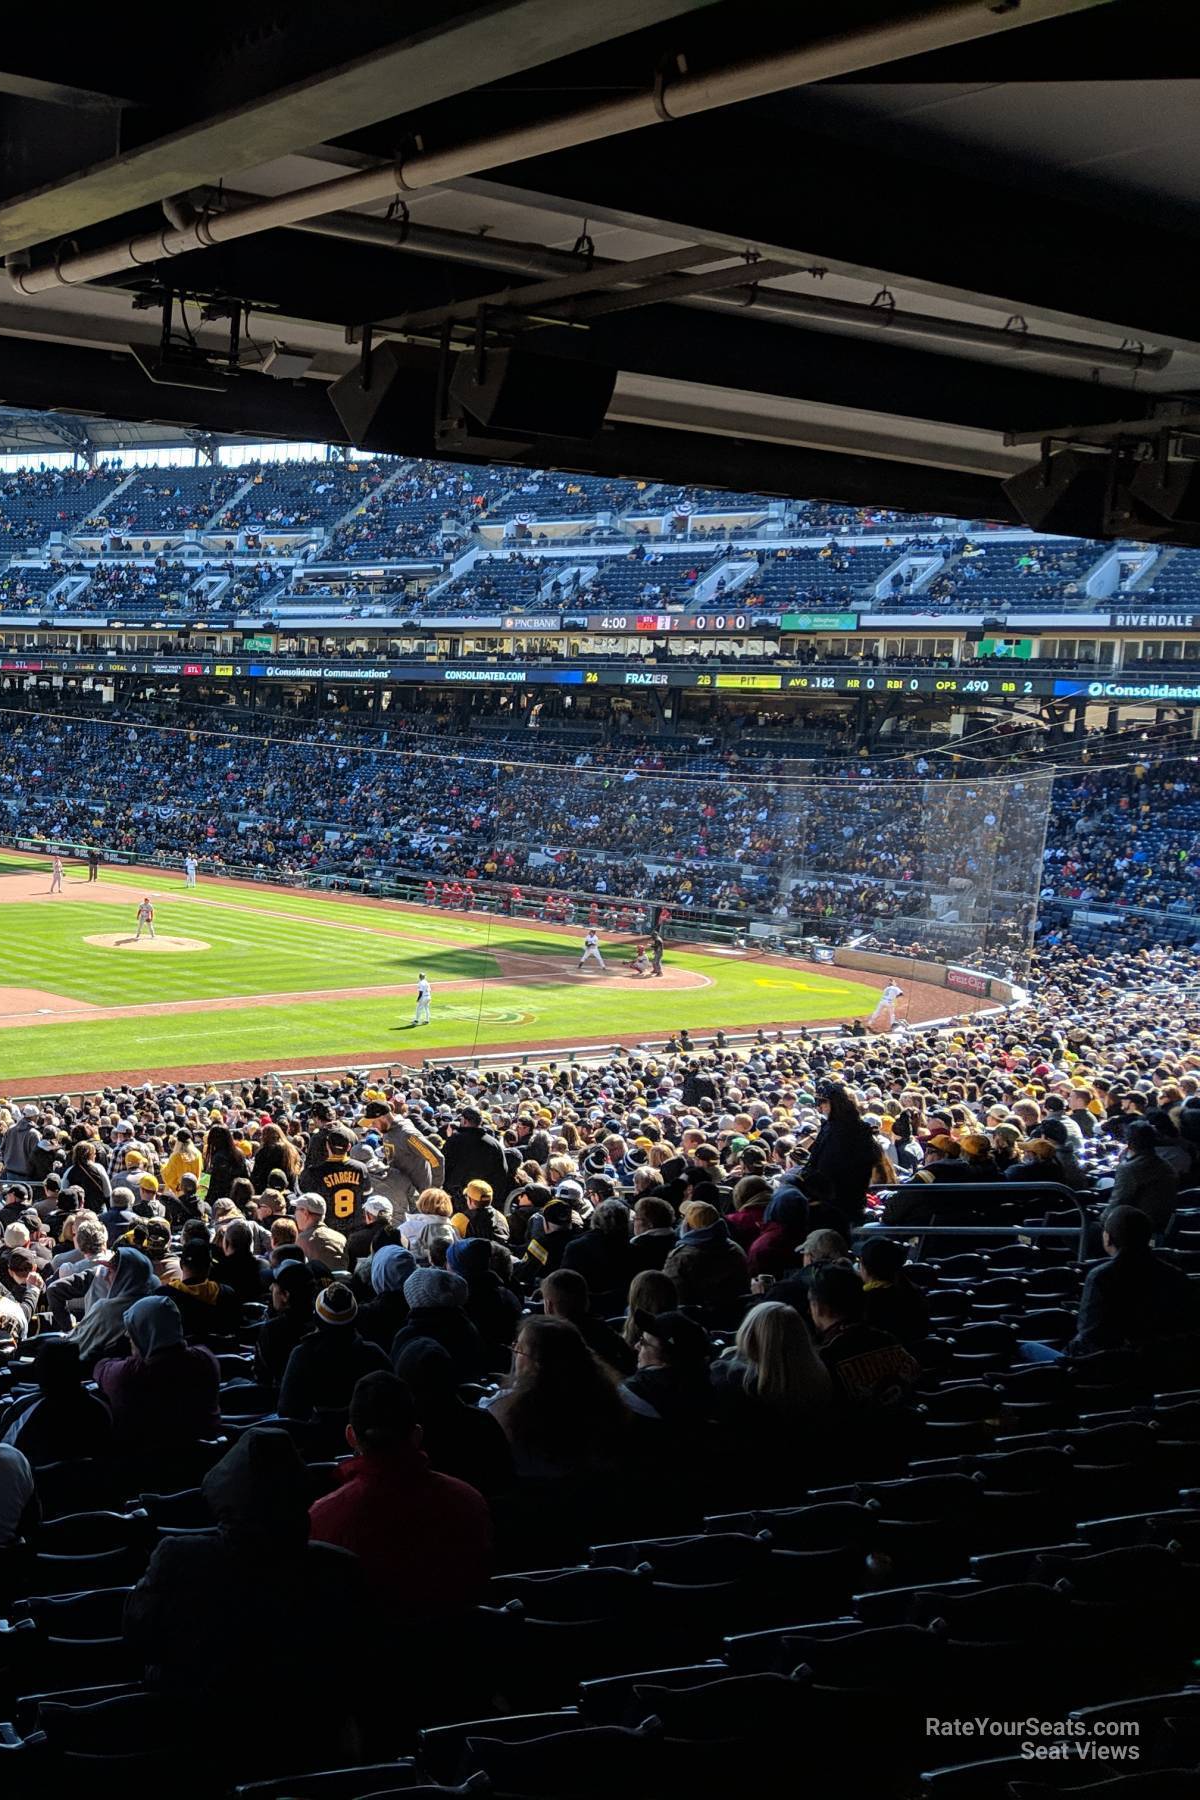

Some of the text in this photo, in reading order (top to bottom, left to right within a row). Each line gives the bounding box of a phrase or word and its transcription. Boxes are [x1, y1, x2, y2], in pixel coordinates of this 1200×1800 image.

[515, 619, 557, 627] PNC BANK
[601, 618, 626, 628] 4:00
[697, 616, 744, 629] 0 0 0
[1117, 616, 1193, 626] RIVENDALE
[15, 661, 28, 669] STL
[132, 664, 136, 672] 6
[275, 668, 389, 678] Consolidated Communications
[445, 671, 526, 681] CONSOLIDATED.COM
[586, 672, 757, 685] 26 FRAZIER 2B PIT
[789, 678, 1032, 693] AVG .182 HR 0 RBI 0 OPS .490 BB 2
[948, 971, 967, 985] Great
[324, 1171, 360, 1188] STARGELL
[335, 1189, 354, 1217] 8
